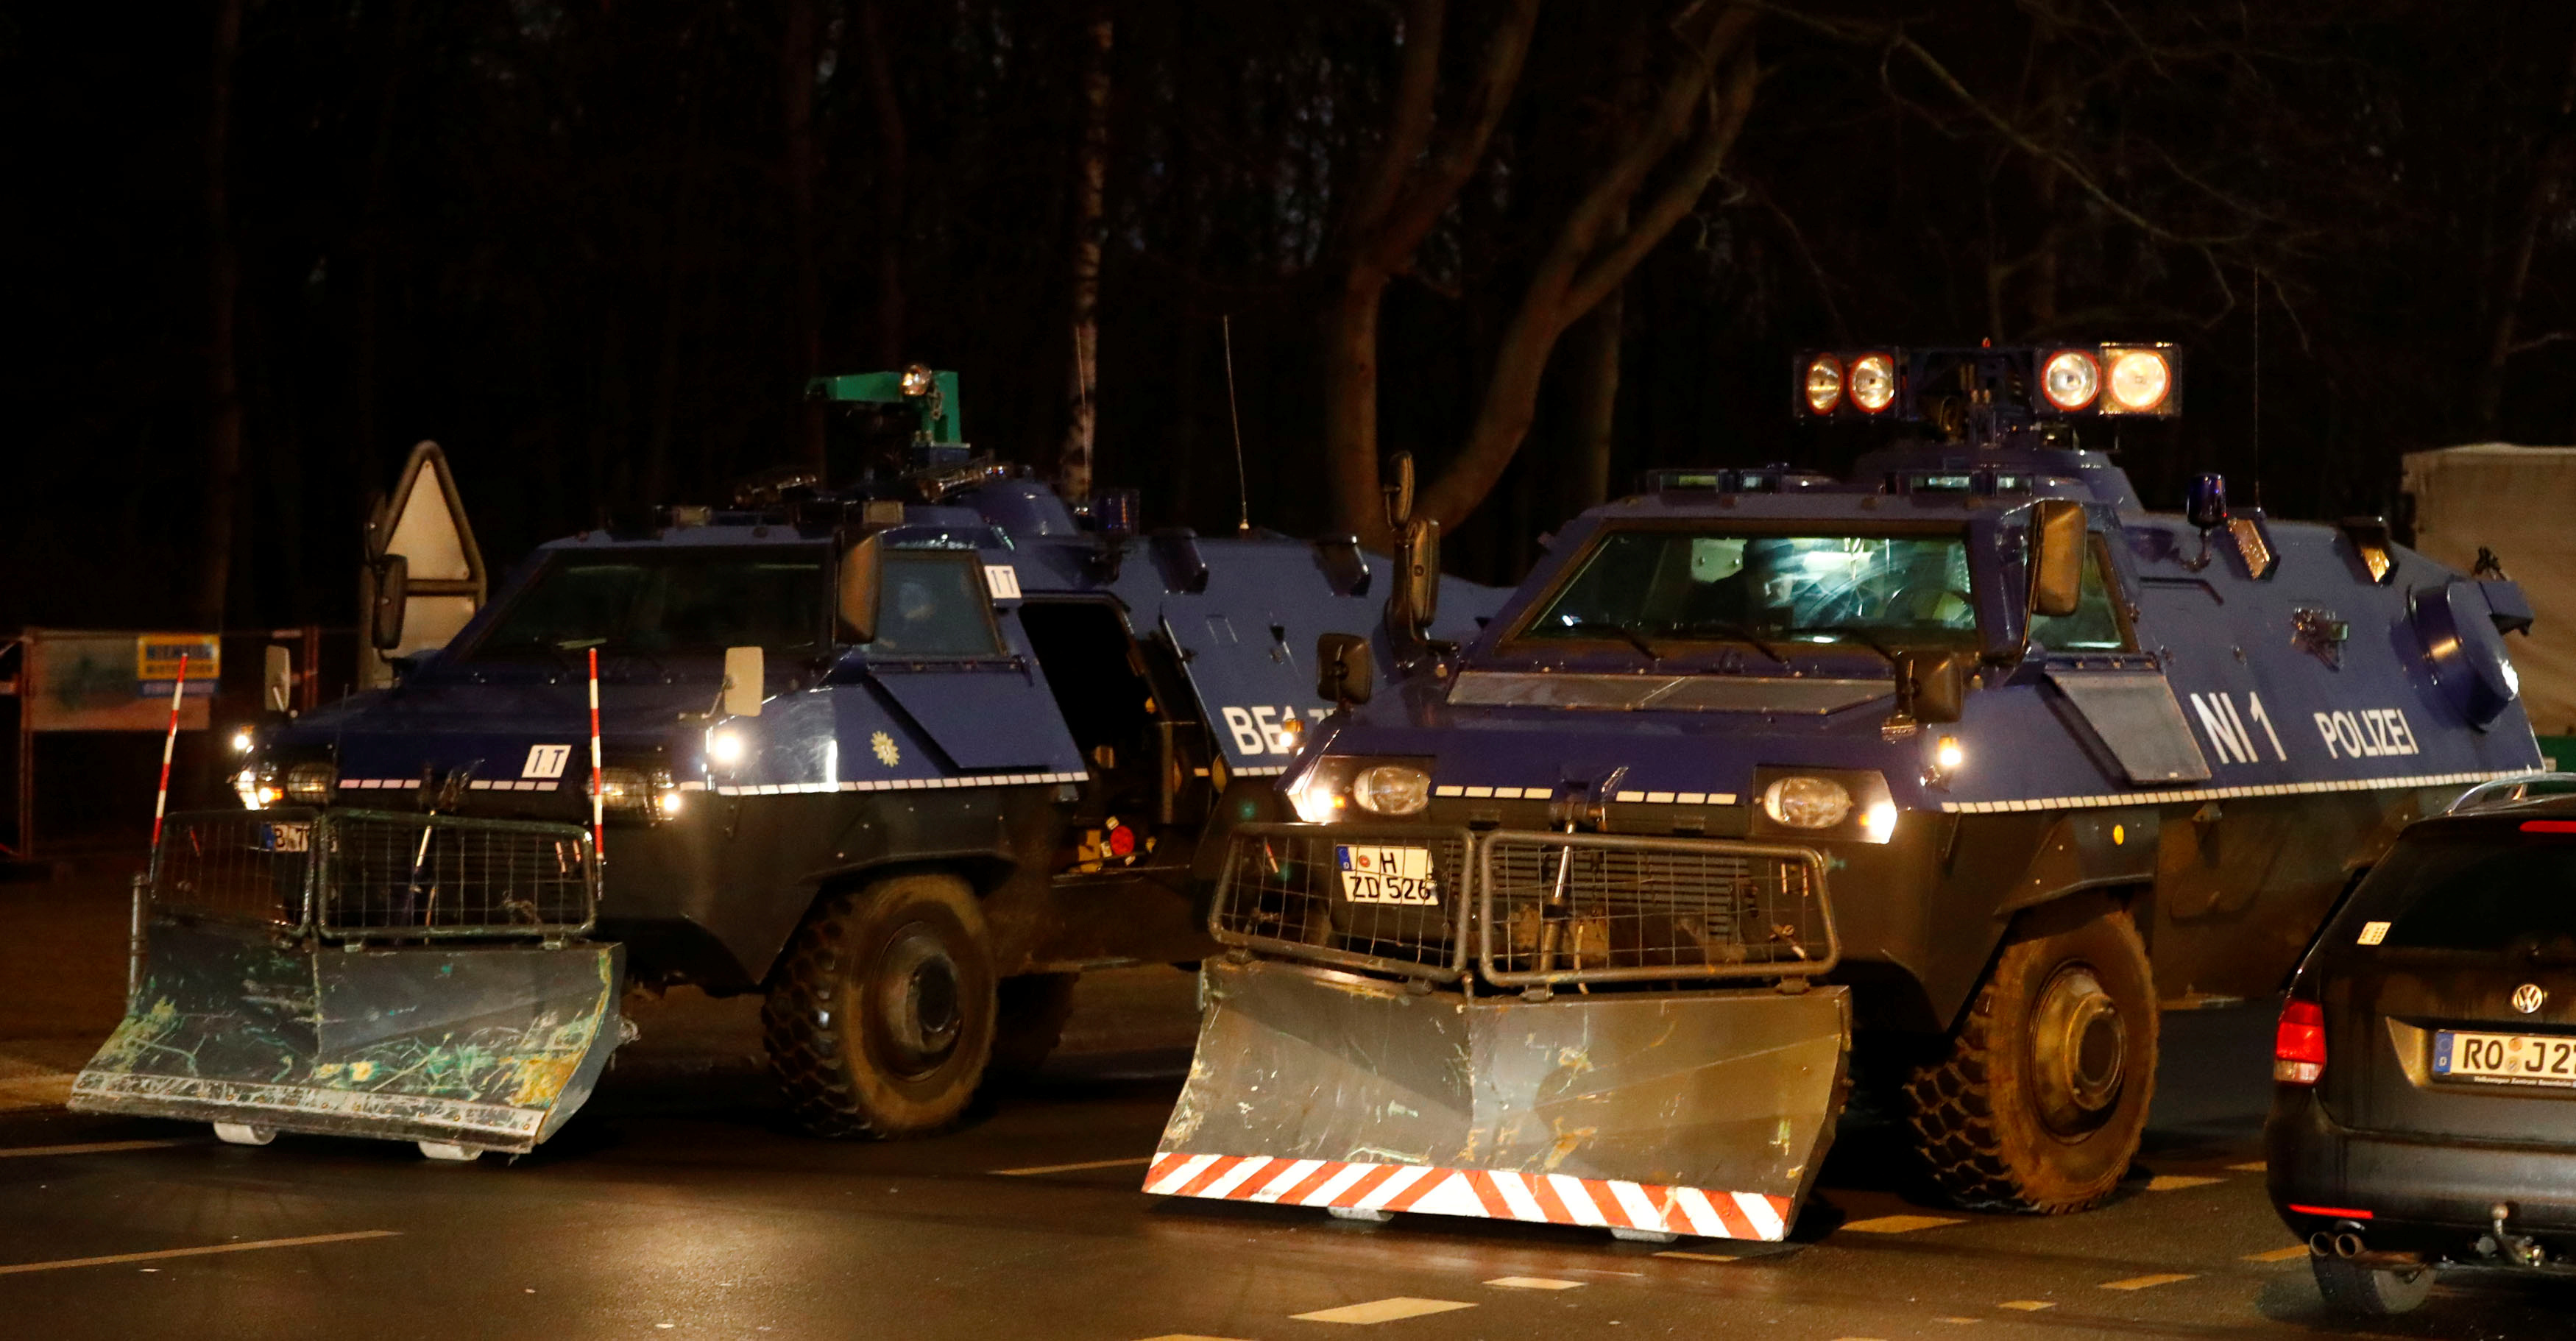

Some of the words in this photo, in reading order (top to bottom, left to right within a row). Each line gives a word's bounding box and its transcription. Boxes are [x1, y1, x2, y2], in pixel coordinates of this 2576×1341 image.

[2190, 692, 2259, 764] NI
[2250, 691, 2287, 761] 1
[2313, 709, 2419, 759] POLIZEI
[1381, 852, 1397, 874] H
[1349, 876, 1380, 898] ZD
[1386, 877, 1431, 900] 526
[2463, 1039, 2504, 1070] RO
